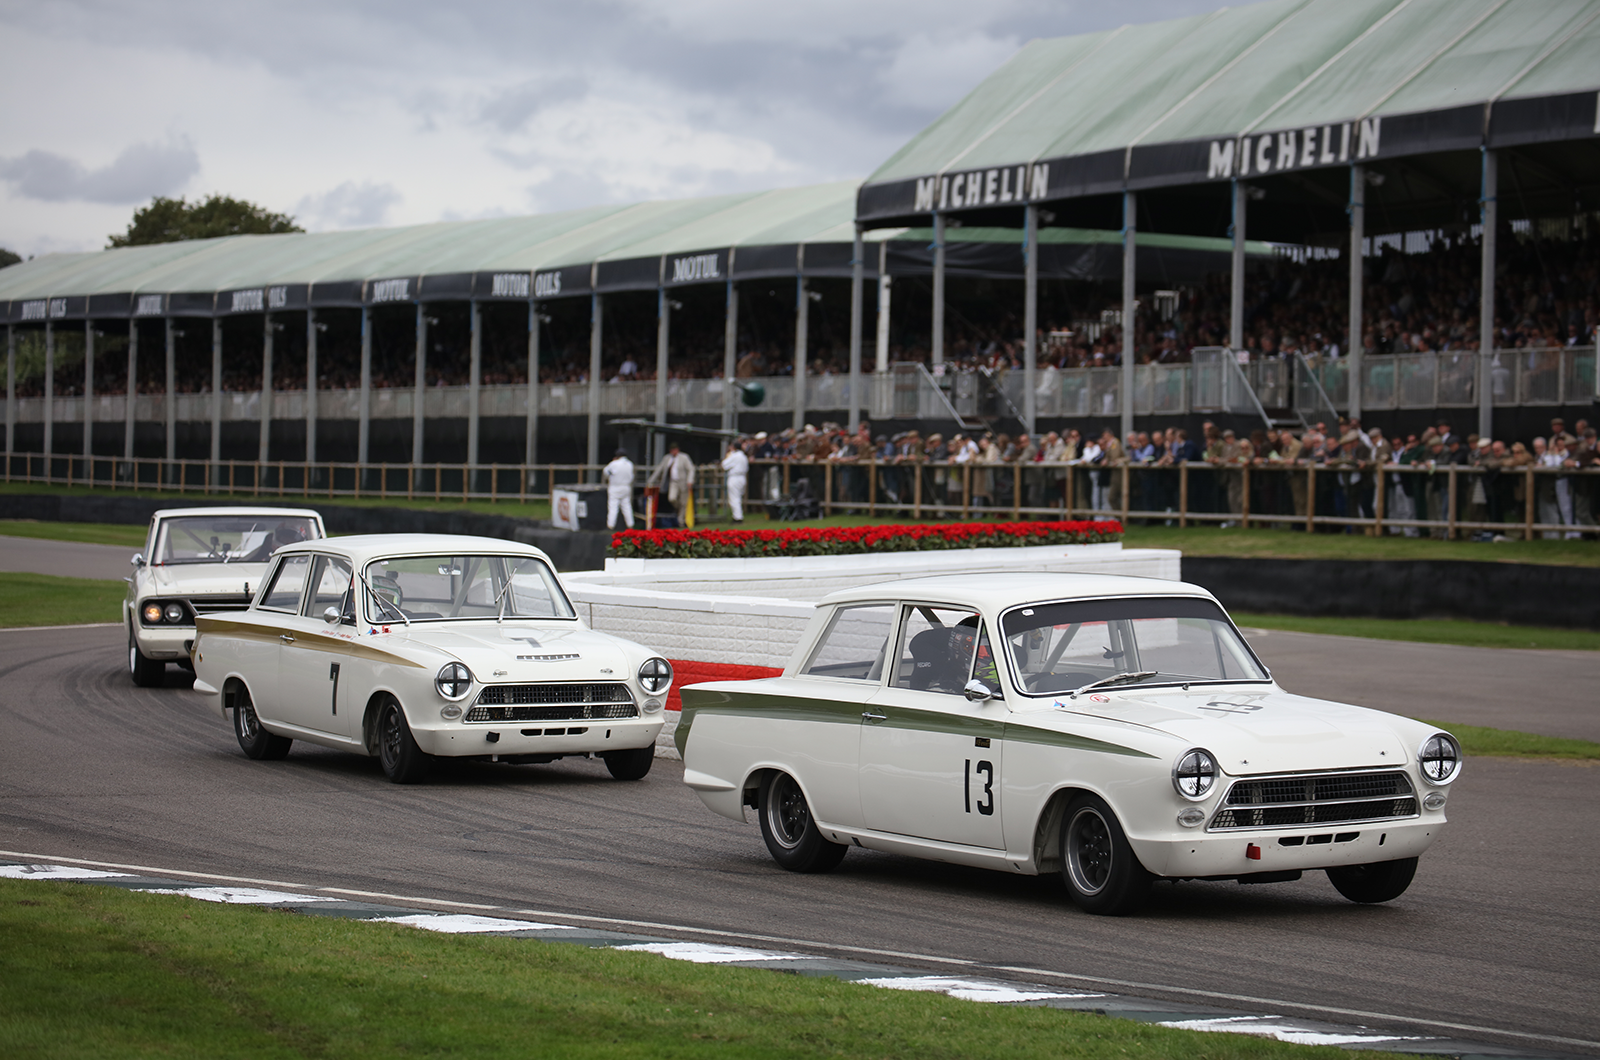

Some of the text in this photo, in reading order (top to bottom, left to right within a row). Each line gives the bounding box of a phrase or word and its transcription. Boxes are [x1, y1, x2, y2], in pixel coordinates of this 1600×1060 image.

[1207, 117, 1381, 179] MICHELIN
[914, 163, 1050, 212] MICHELIN
[672, 253, 720, 283] MOTUL
[231, 285, 287, 312] MOTOR OILS
[371, 279, 410, 303] MOTUL
[491, 270, 562, 298] MOTOR OILS
[50, 297, 67, 319] OILS
[329, 661, 341, 717] 7
[964, 758, 994, 816] 13
